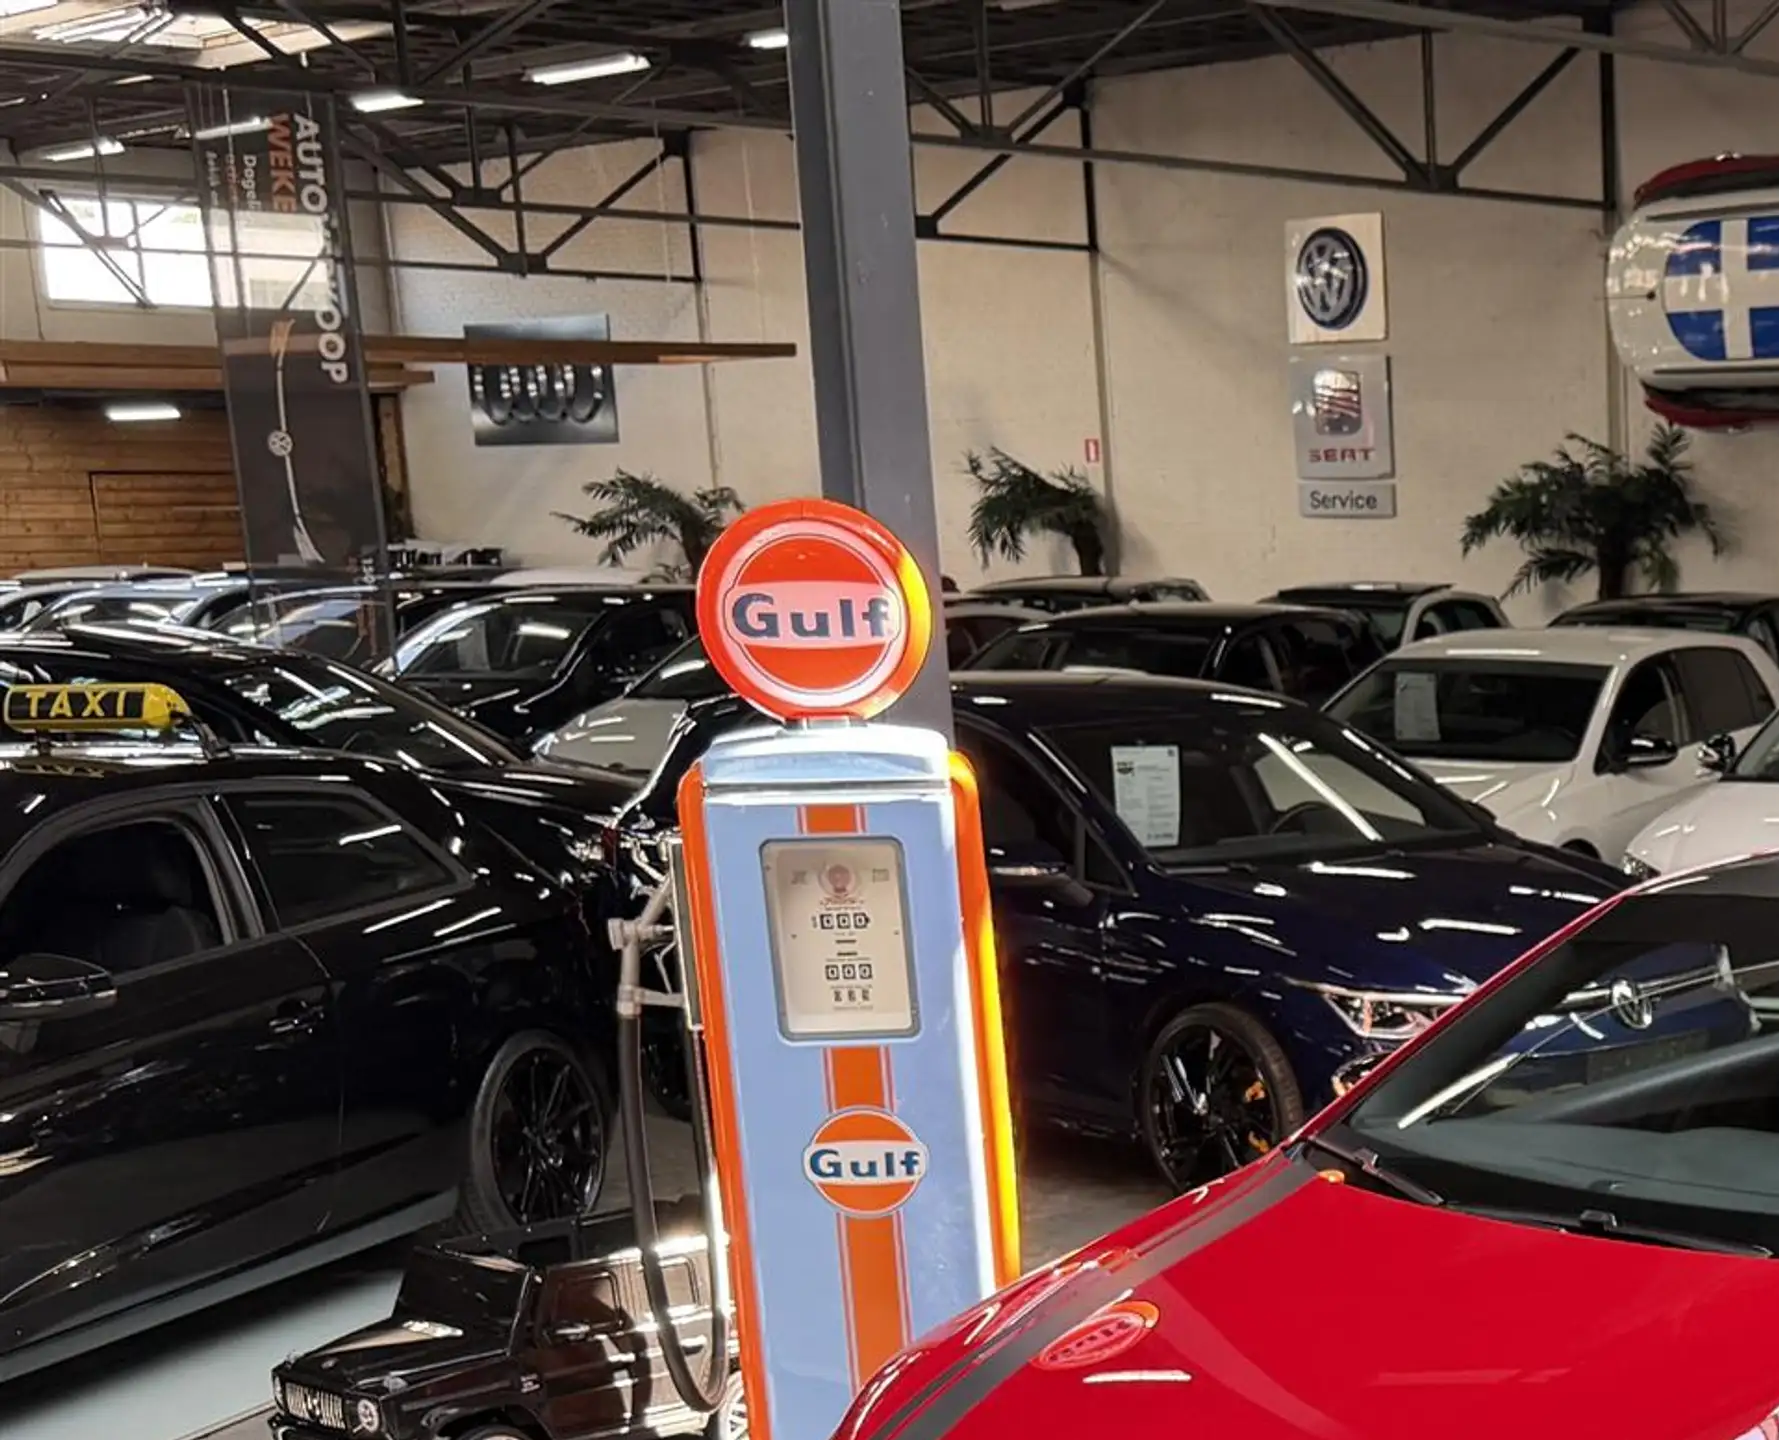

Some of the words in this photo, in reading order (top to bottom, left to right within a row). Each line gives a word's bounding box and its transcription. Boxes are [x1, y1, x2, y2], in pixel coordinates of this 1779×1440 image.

[294, 113, 348, 383] AUTOOOP
[1308, 447, 1376, 463] SEAT
[1309, 490, 1378, 511] Service
[731, 592, 890, 639] Gulf
[25, 689, 127, 718] TAXI
[808, 1148, 922, 1179] Gulf
